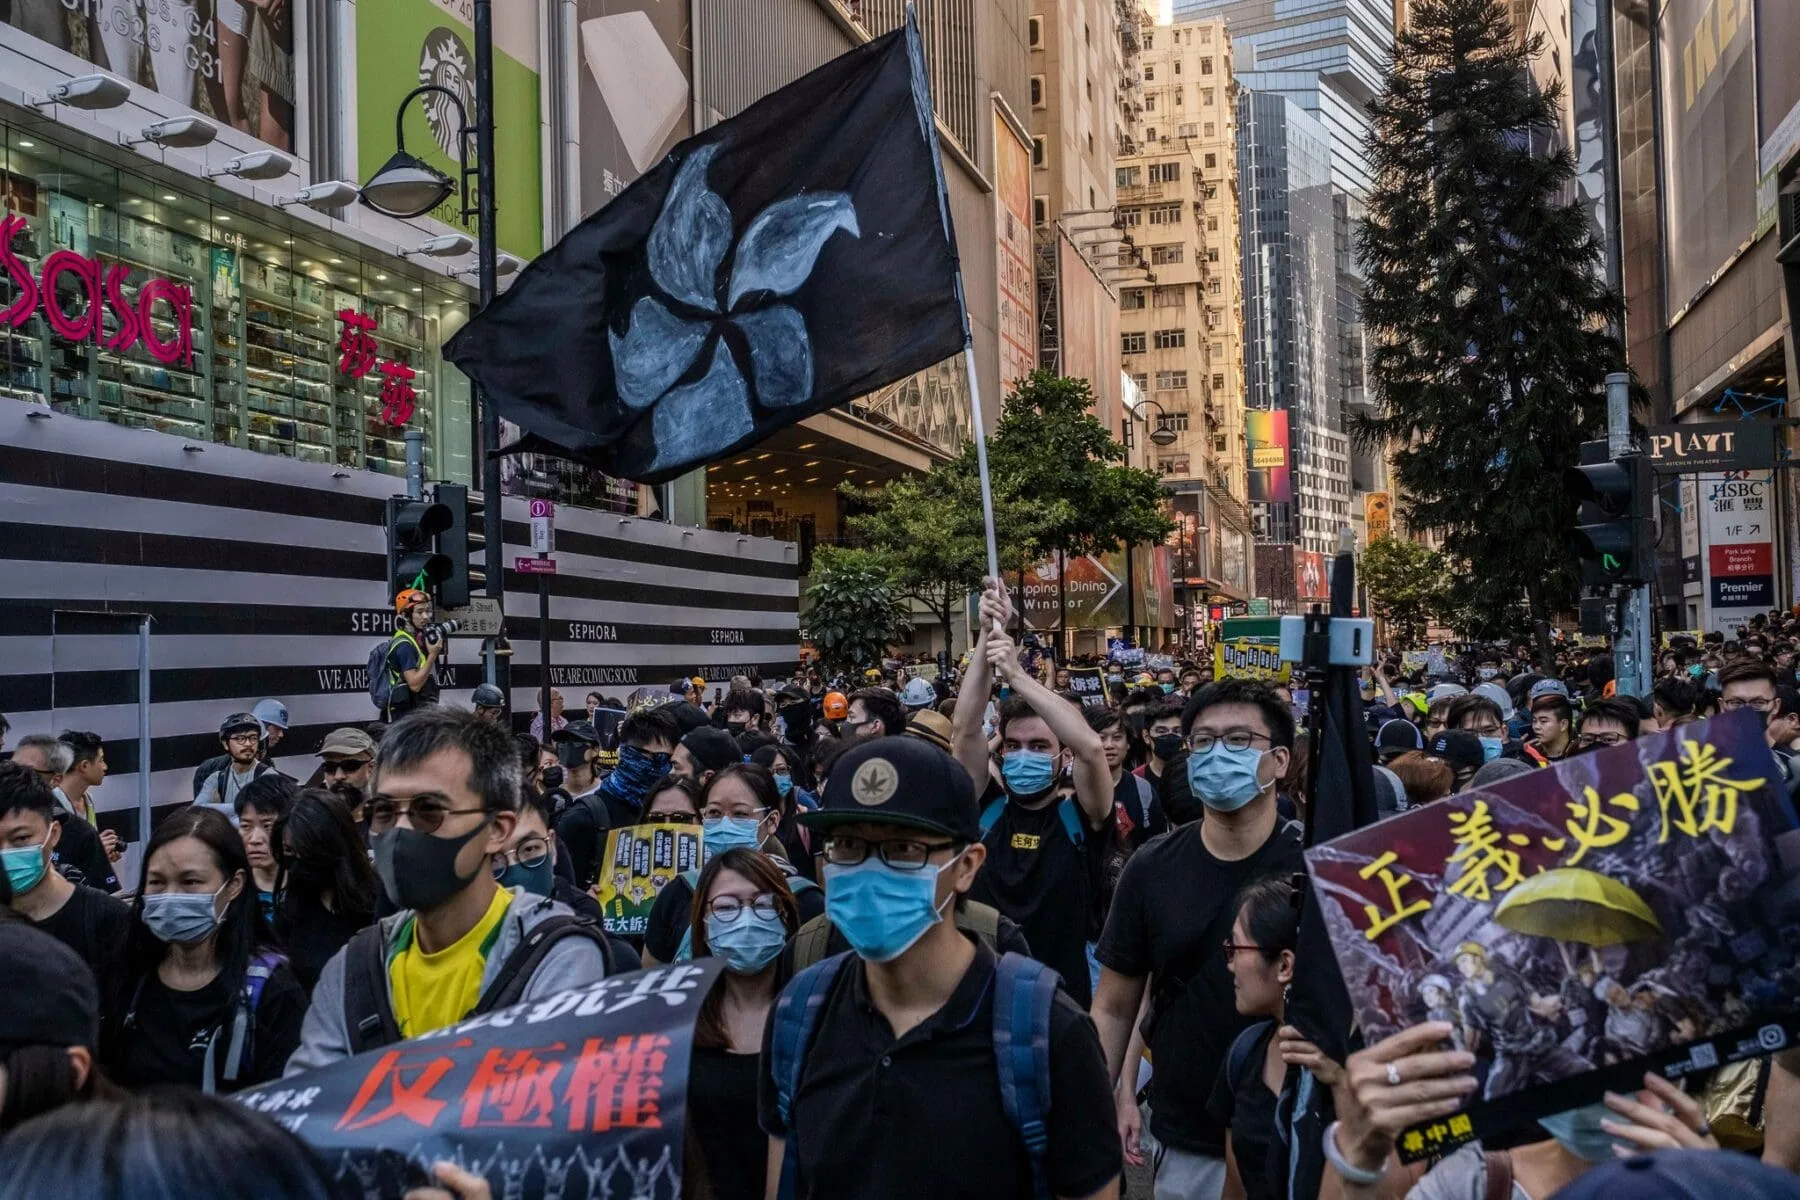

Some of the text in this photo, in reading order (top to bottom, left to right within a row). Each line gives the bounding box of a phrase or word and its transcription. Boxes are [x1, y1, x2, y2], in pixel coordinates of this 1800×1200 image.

[184, 8, 215, 46] G4
[111, 5, 162, 53] G26
[183, 42, 223, 84] G31
[430, 200, 461, 226] HOP
[224, 232, 248, 249] CARE
[1712, 482, 1763, 498] HSBC
[1725, 525, 1742, 536] 1/F
[1070, 580, 1107, 594] Dining
[1720, 582, 1763, 593] Premier
[351, 612, 405, 633] SEPHO
[568, 623, 617, 640] SEPHORA
[711, 630, 745, 643] SEPHORA
[318, 669, 342, 690] WE
[343, 668, 370, 688] ARE
[549, 668, 566, 684] WE
[566, 667, 582, 684] ARE
[582, 667, 614, 683] COMING
[1359, 739, 1767, 941] 正義必勝
[334, 1032, 672, 1133] 反極權
